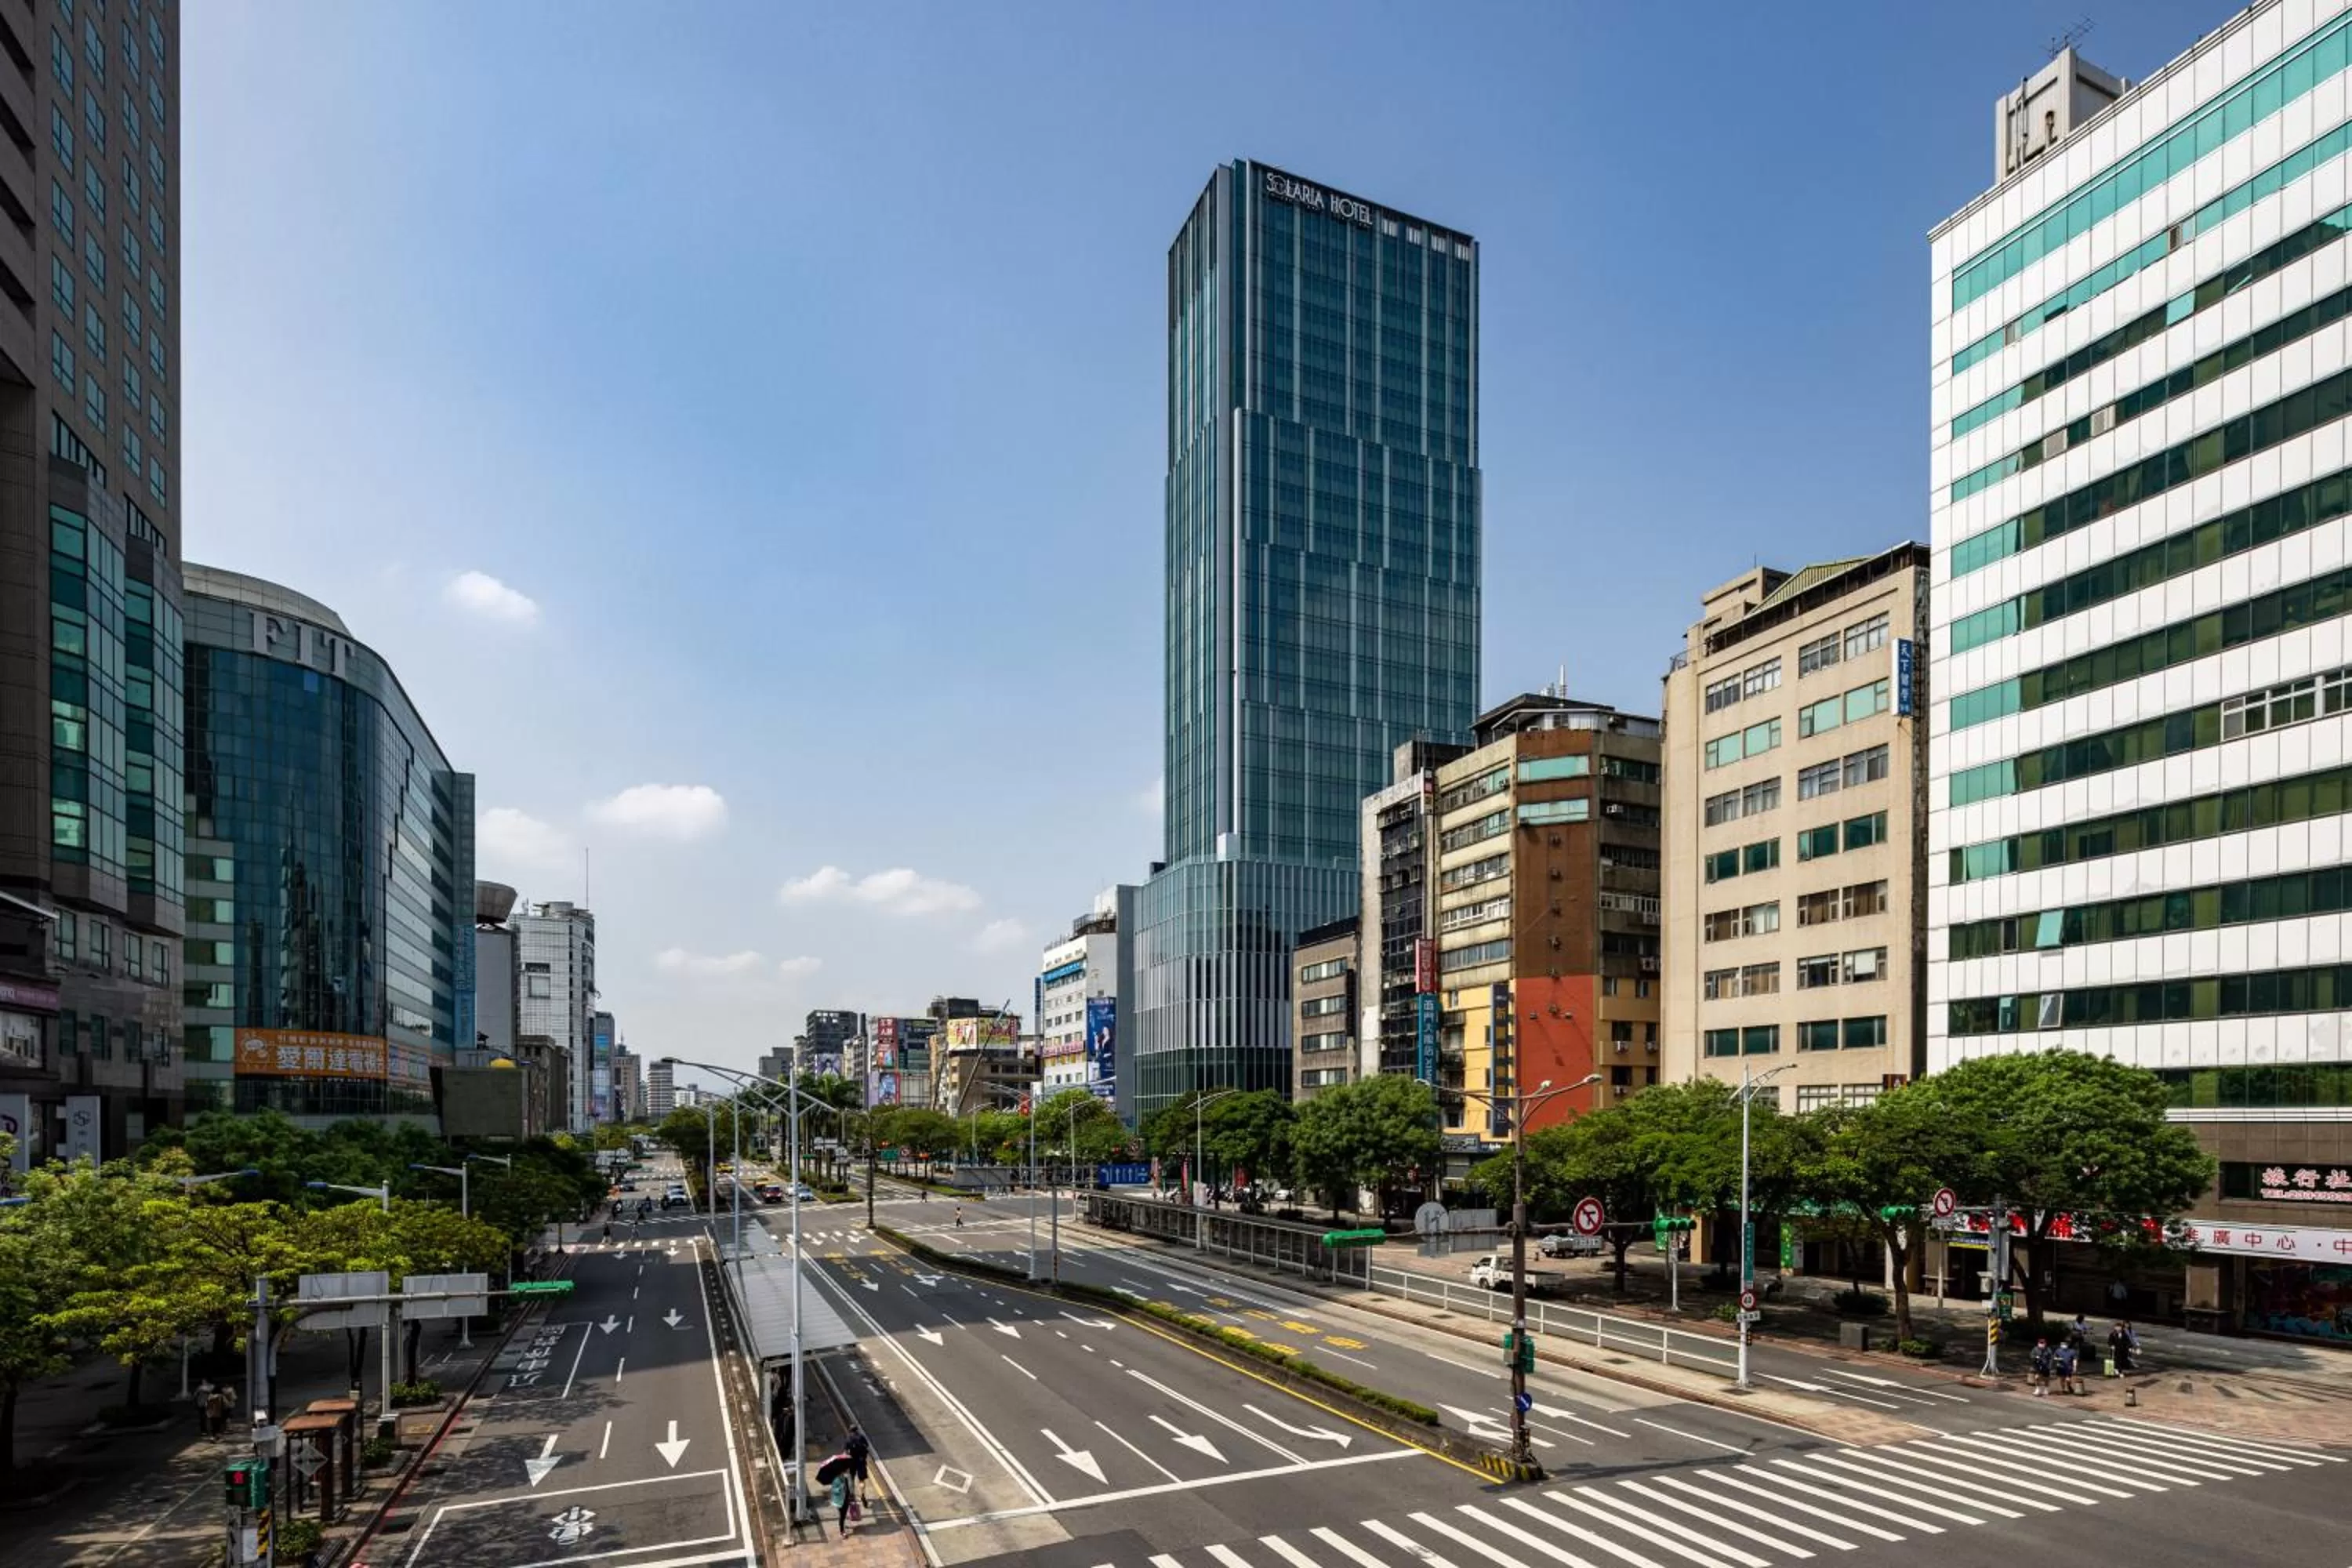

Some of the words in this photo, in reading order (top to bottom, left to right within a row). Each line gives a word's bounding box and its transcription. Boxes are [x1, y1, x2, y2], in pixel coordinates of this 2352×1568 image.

[1266, 172, 1324, 210] SOLARIA
[1330, 194, 1373, 225] HOTEL
[250, 611, 356, 679] FIT
[2262, 1167, 2352, 1189] 旅行社
